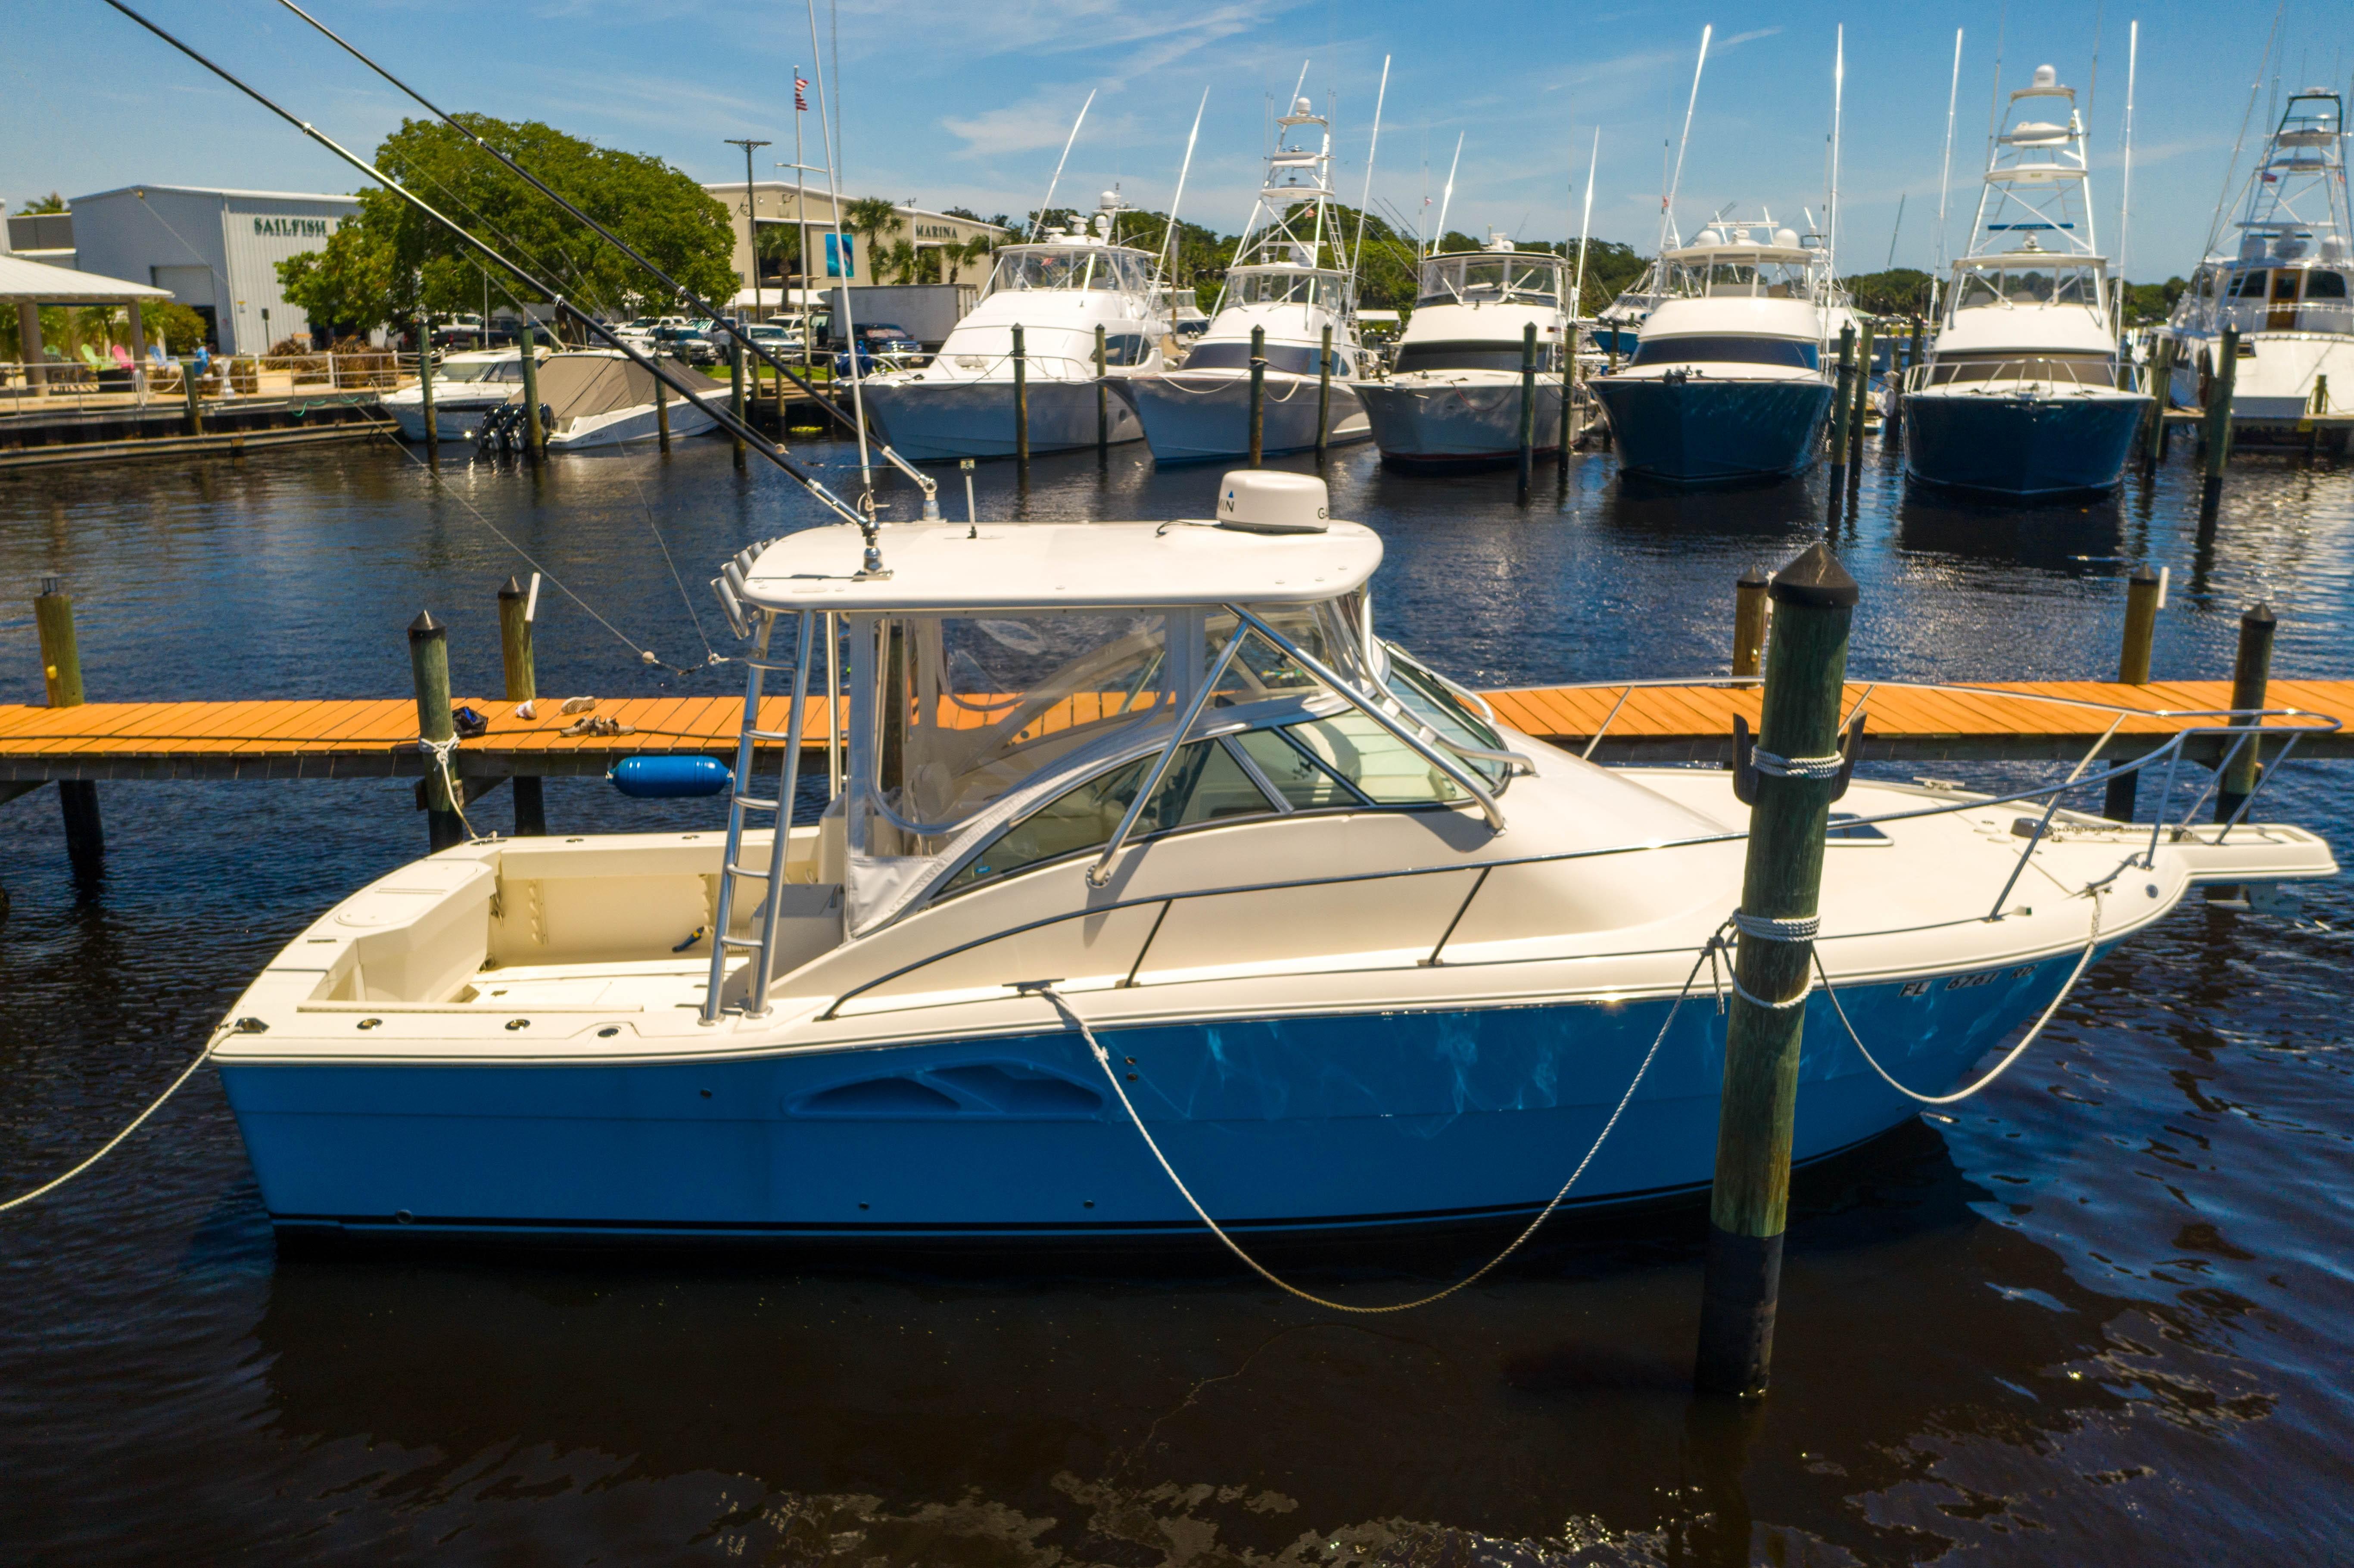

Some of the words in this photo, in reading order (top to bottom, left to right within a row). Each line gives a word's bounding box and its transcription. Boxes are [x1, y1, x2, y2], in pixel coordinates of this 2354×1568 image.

[253, 217, 327, 235] SAILFISH
[916, 225, 957, 238] MARINA
[1899, 982, 1924, 997] FL
